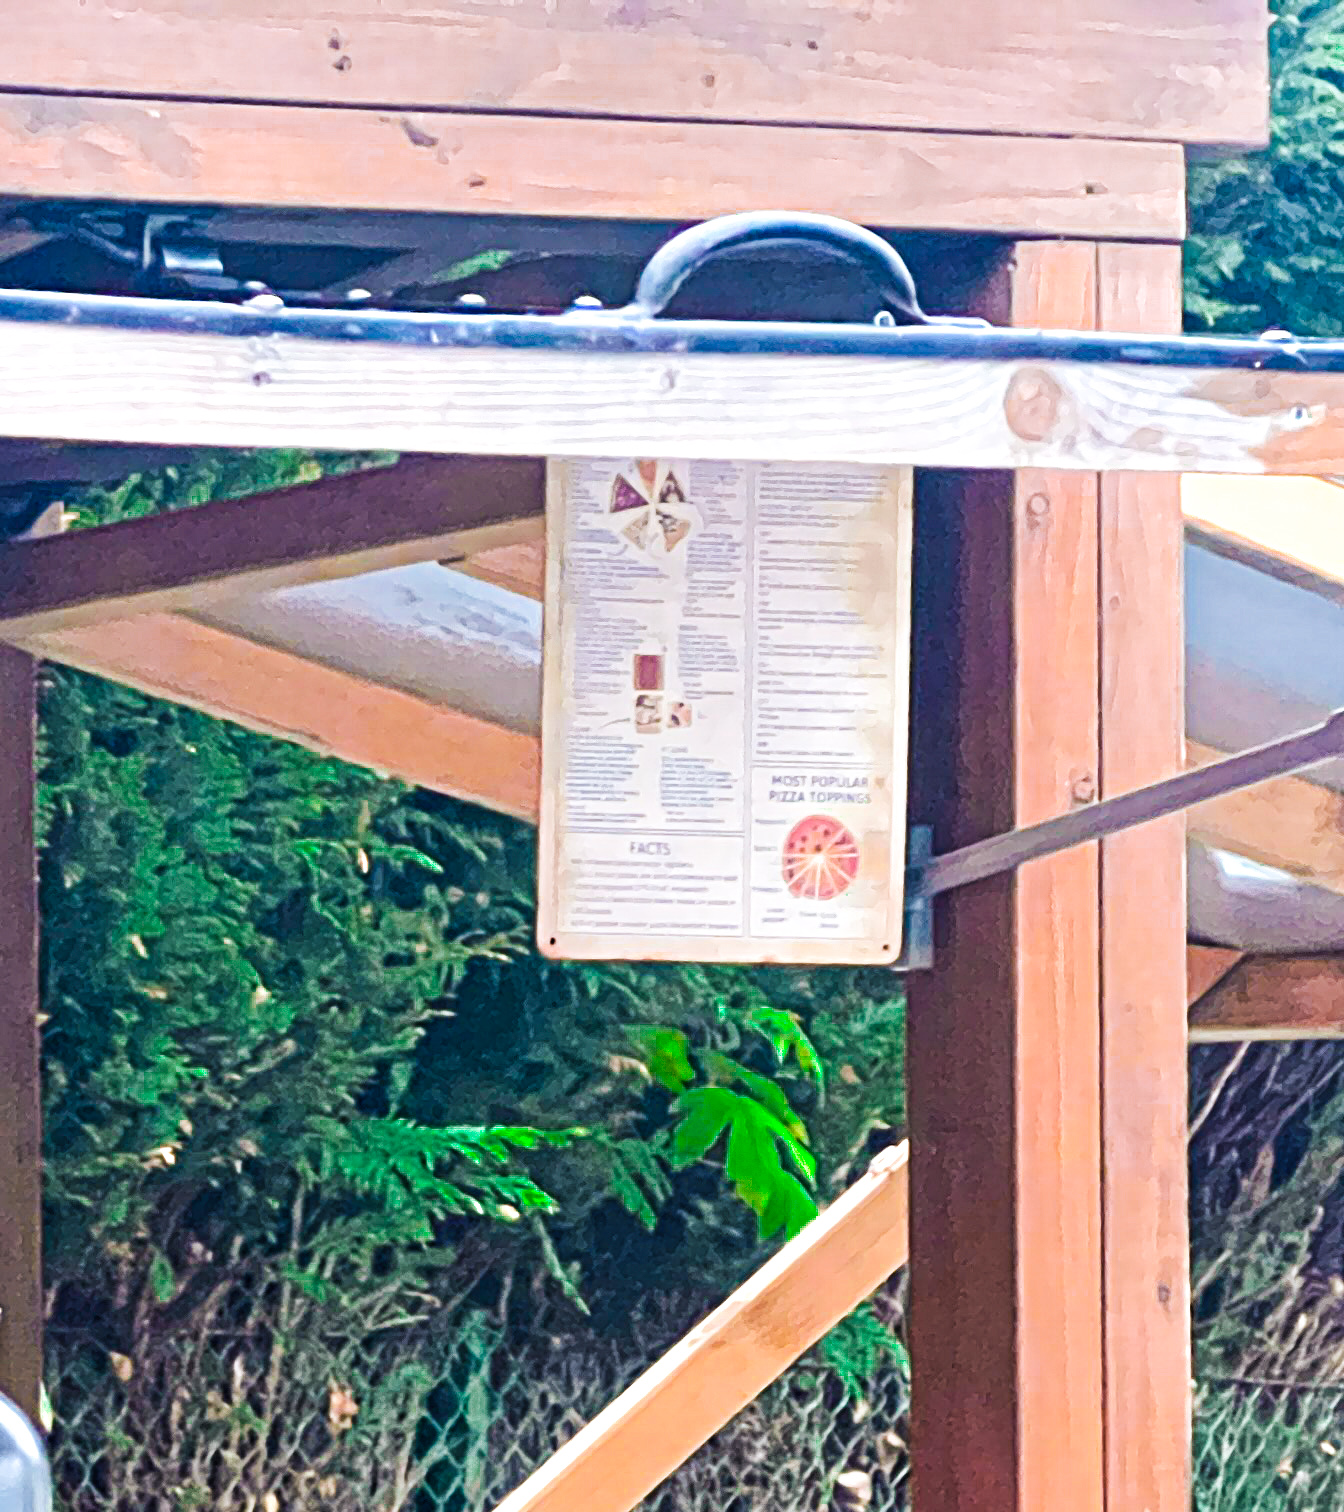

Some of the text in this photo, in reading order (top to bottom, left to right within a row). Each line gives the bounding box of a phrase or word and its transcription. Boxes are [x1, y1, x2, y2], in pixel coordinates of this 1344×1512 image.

[772, 775, 869, 789] MOST POPULAR
[769, 790, 872, 804] PIZZA TOPPINGS
[629, 841, 672, 856] FACTS
